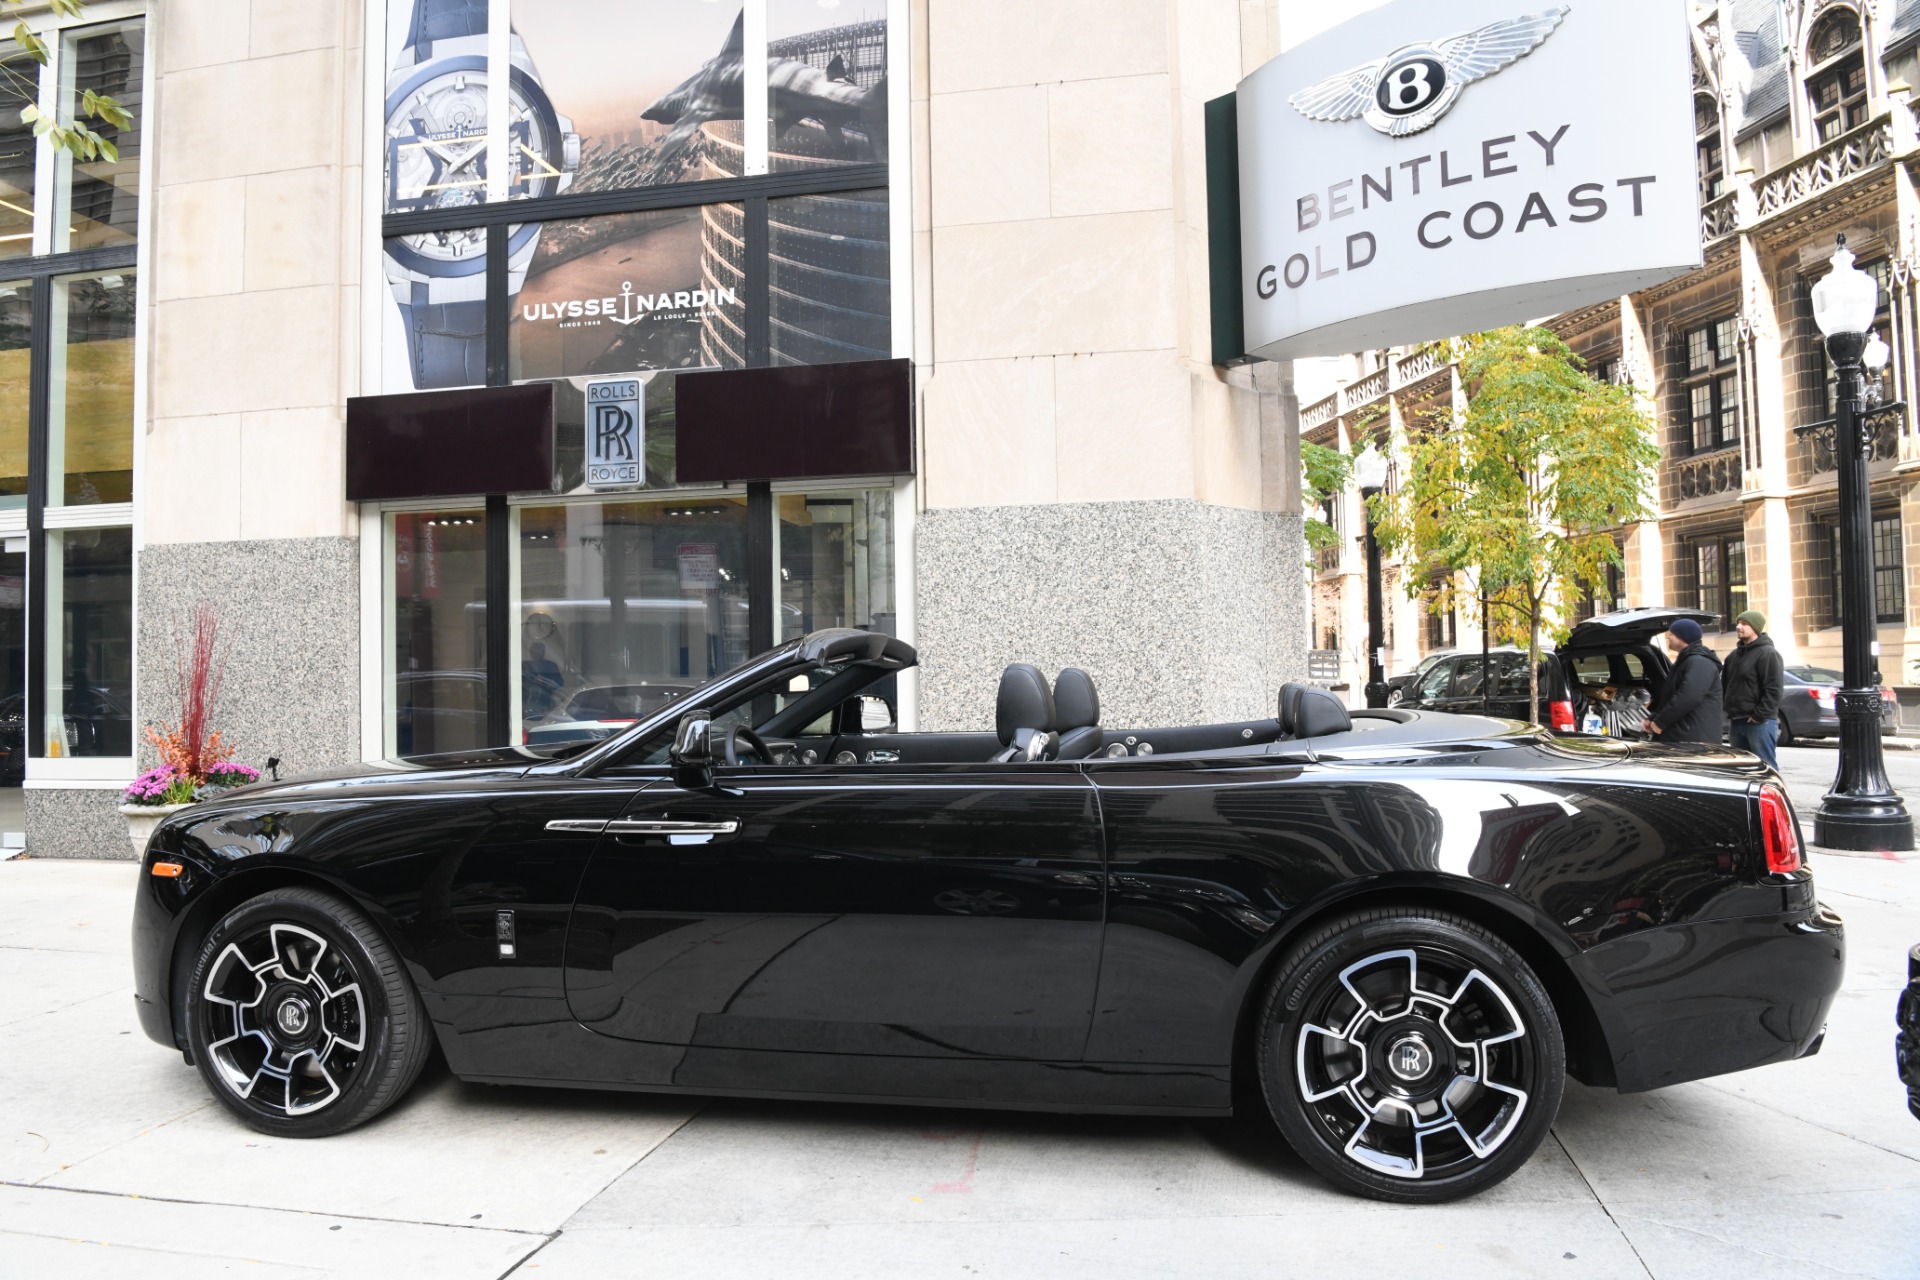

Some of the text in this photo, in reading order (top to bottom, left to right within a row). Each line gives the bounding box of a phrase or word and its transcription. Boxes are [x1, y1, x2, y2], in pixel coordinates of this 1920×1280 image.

[462, 128, 487, 137] NARDI
[1295, 124, 1571, 233] BENTLEY
[1256, 175, 1657, 300] GOLD COAST
[523, 287, 735, 321] ULYSSE NARDIN
[664, 312, 686, 320] LOCLE
[591, 385, 636, 399] ROLLS
[591, 466, 636, 481] ROYCE
[1285, 947, 1340, 1011] Continental
